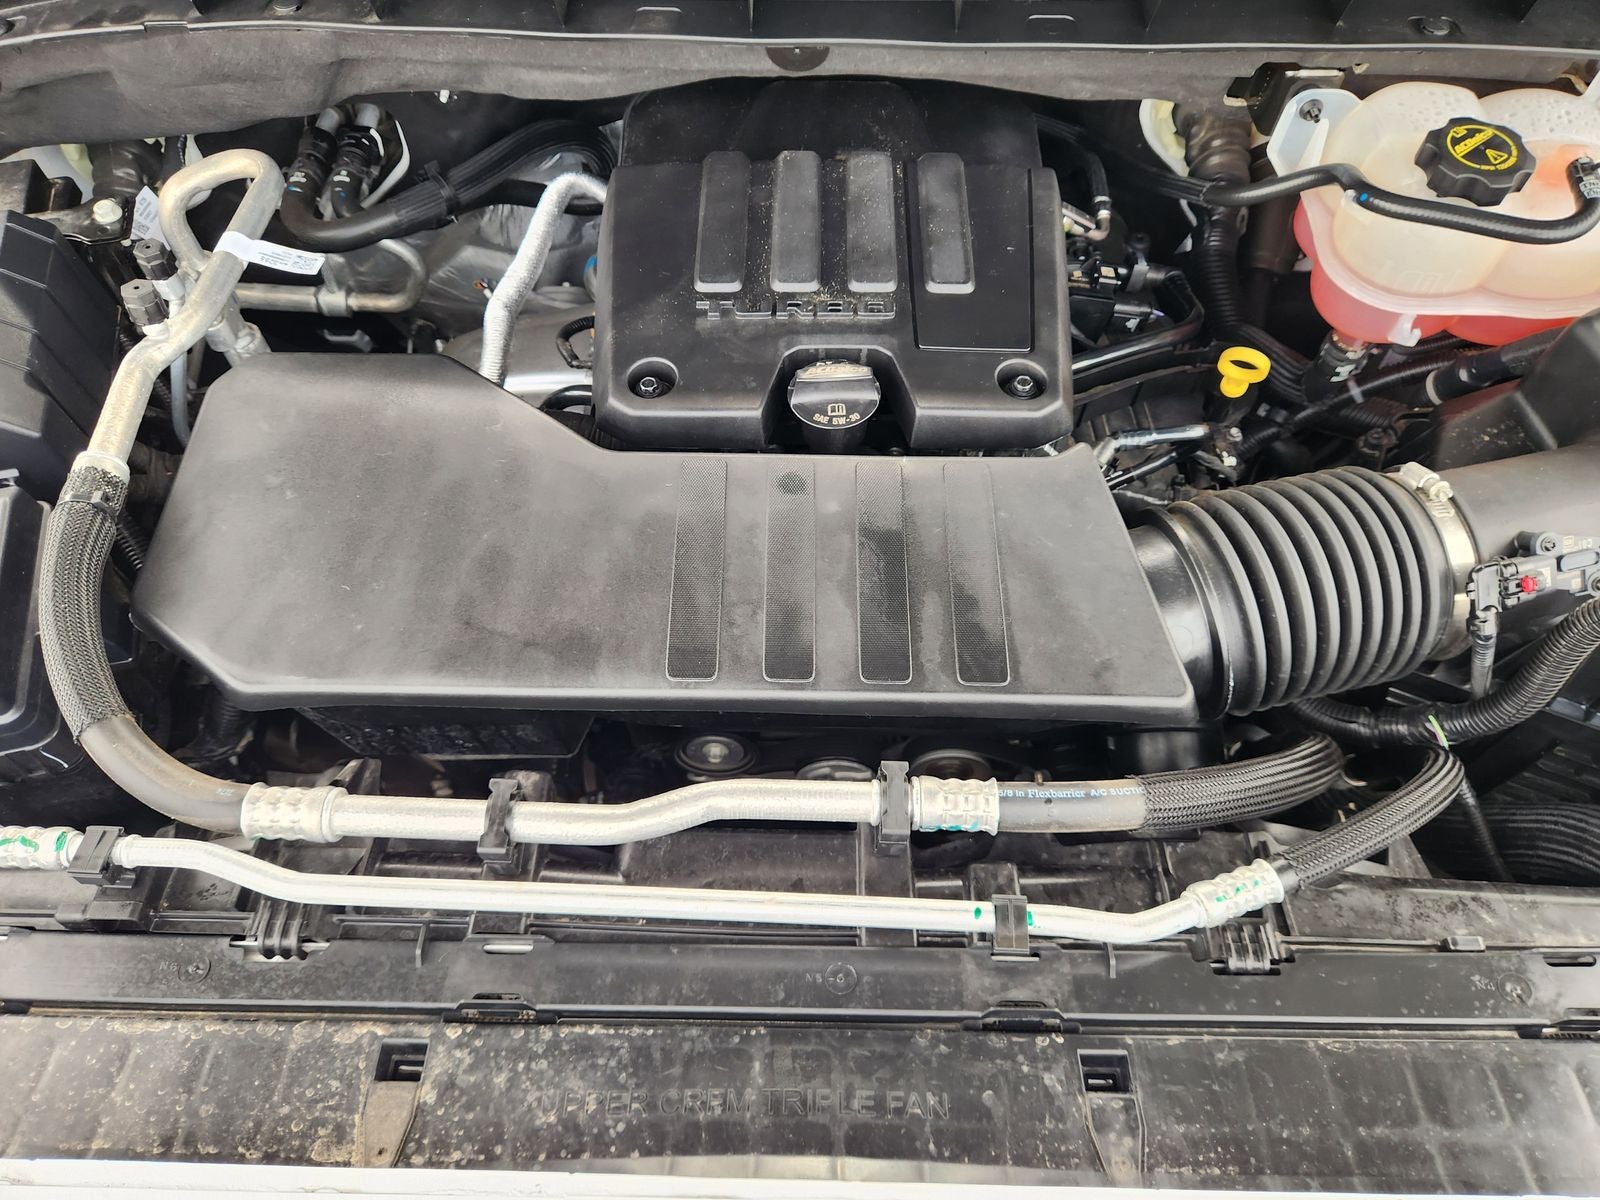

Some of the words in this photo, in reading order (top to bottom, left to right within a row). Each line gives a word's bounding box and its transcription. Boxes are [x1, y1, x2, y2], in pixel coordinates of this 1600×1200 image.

[696, 300, 895, 320] TURBO
[813, 413, 830, 424] SAE
[832, 412, 861, 425] 5W-30
[1028, 788, 1086, 799] Flexbarrier
[761, 1088, 877, 1116] TRIPLE
[886, 1090, 950, 1119] FAN
